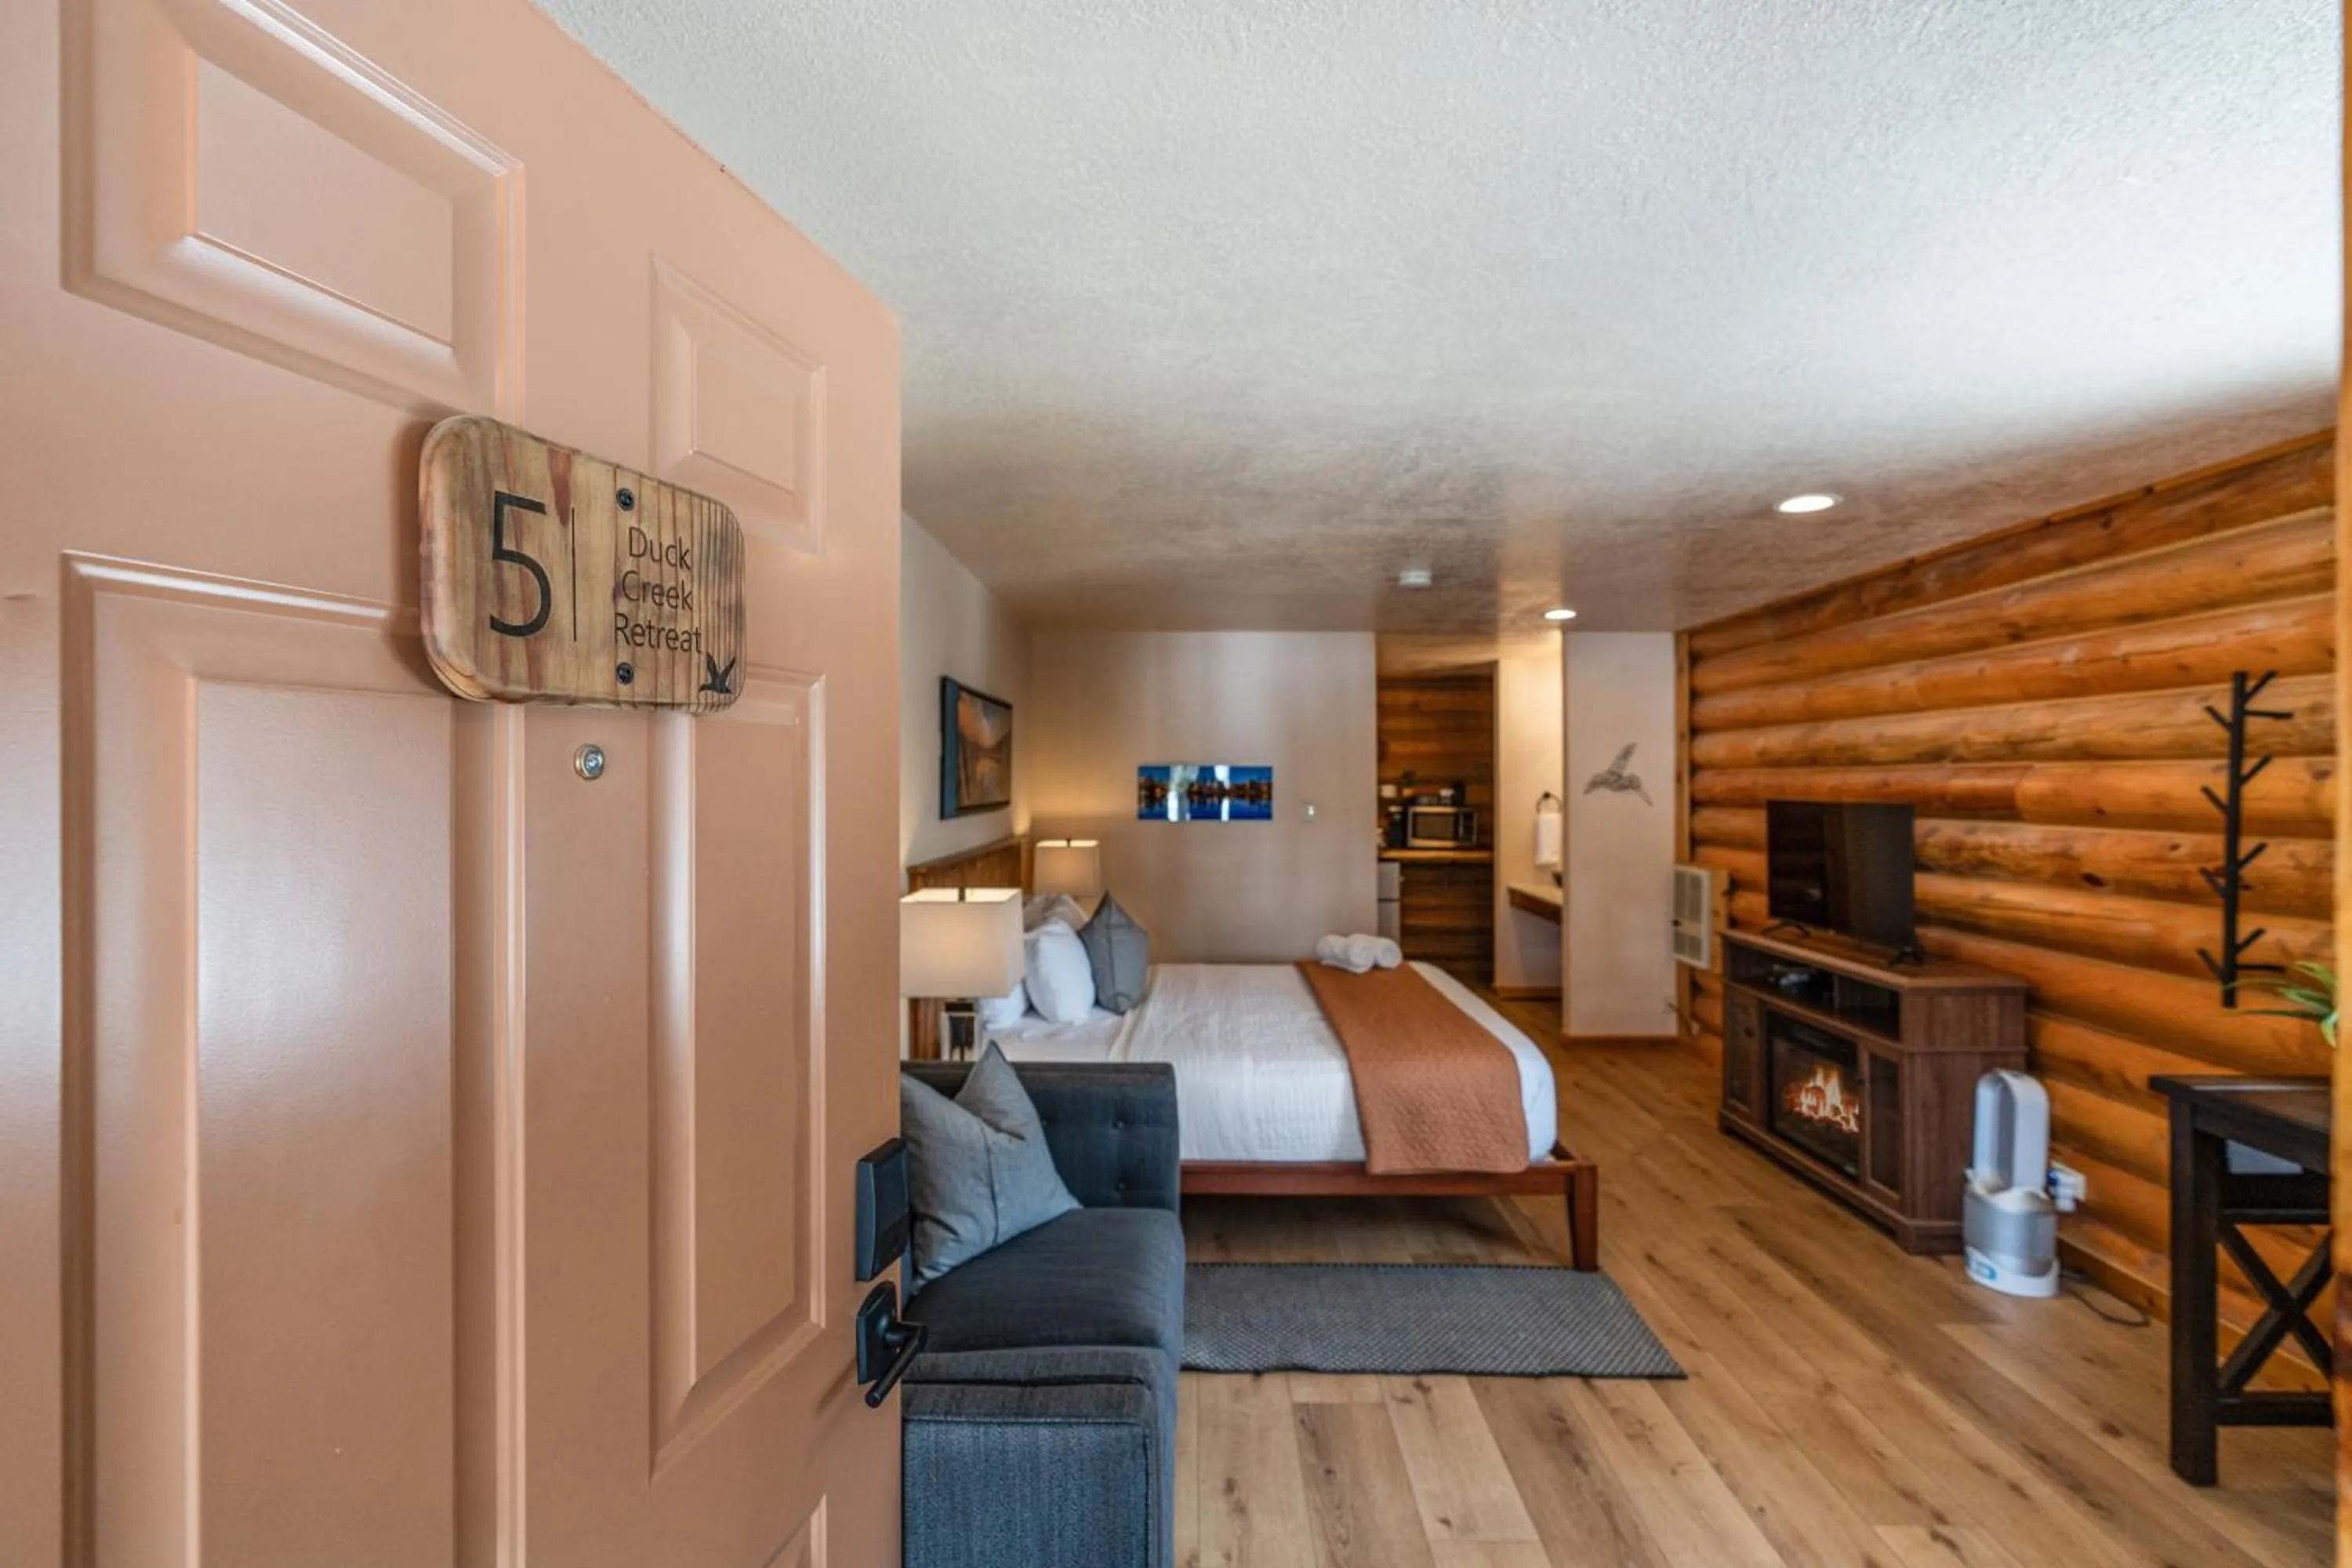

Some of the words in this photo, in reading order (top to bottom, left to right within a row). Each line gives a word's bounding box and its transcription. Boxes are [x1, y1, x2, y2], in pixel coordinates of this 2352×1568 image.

[490, 491, 551, 637] 5
[629, 527, 691, 571] Duck
[622, 571, 693, 611] Creek
[615, 612, 702, 654] Retreat
